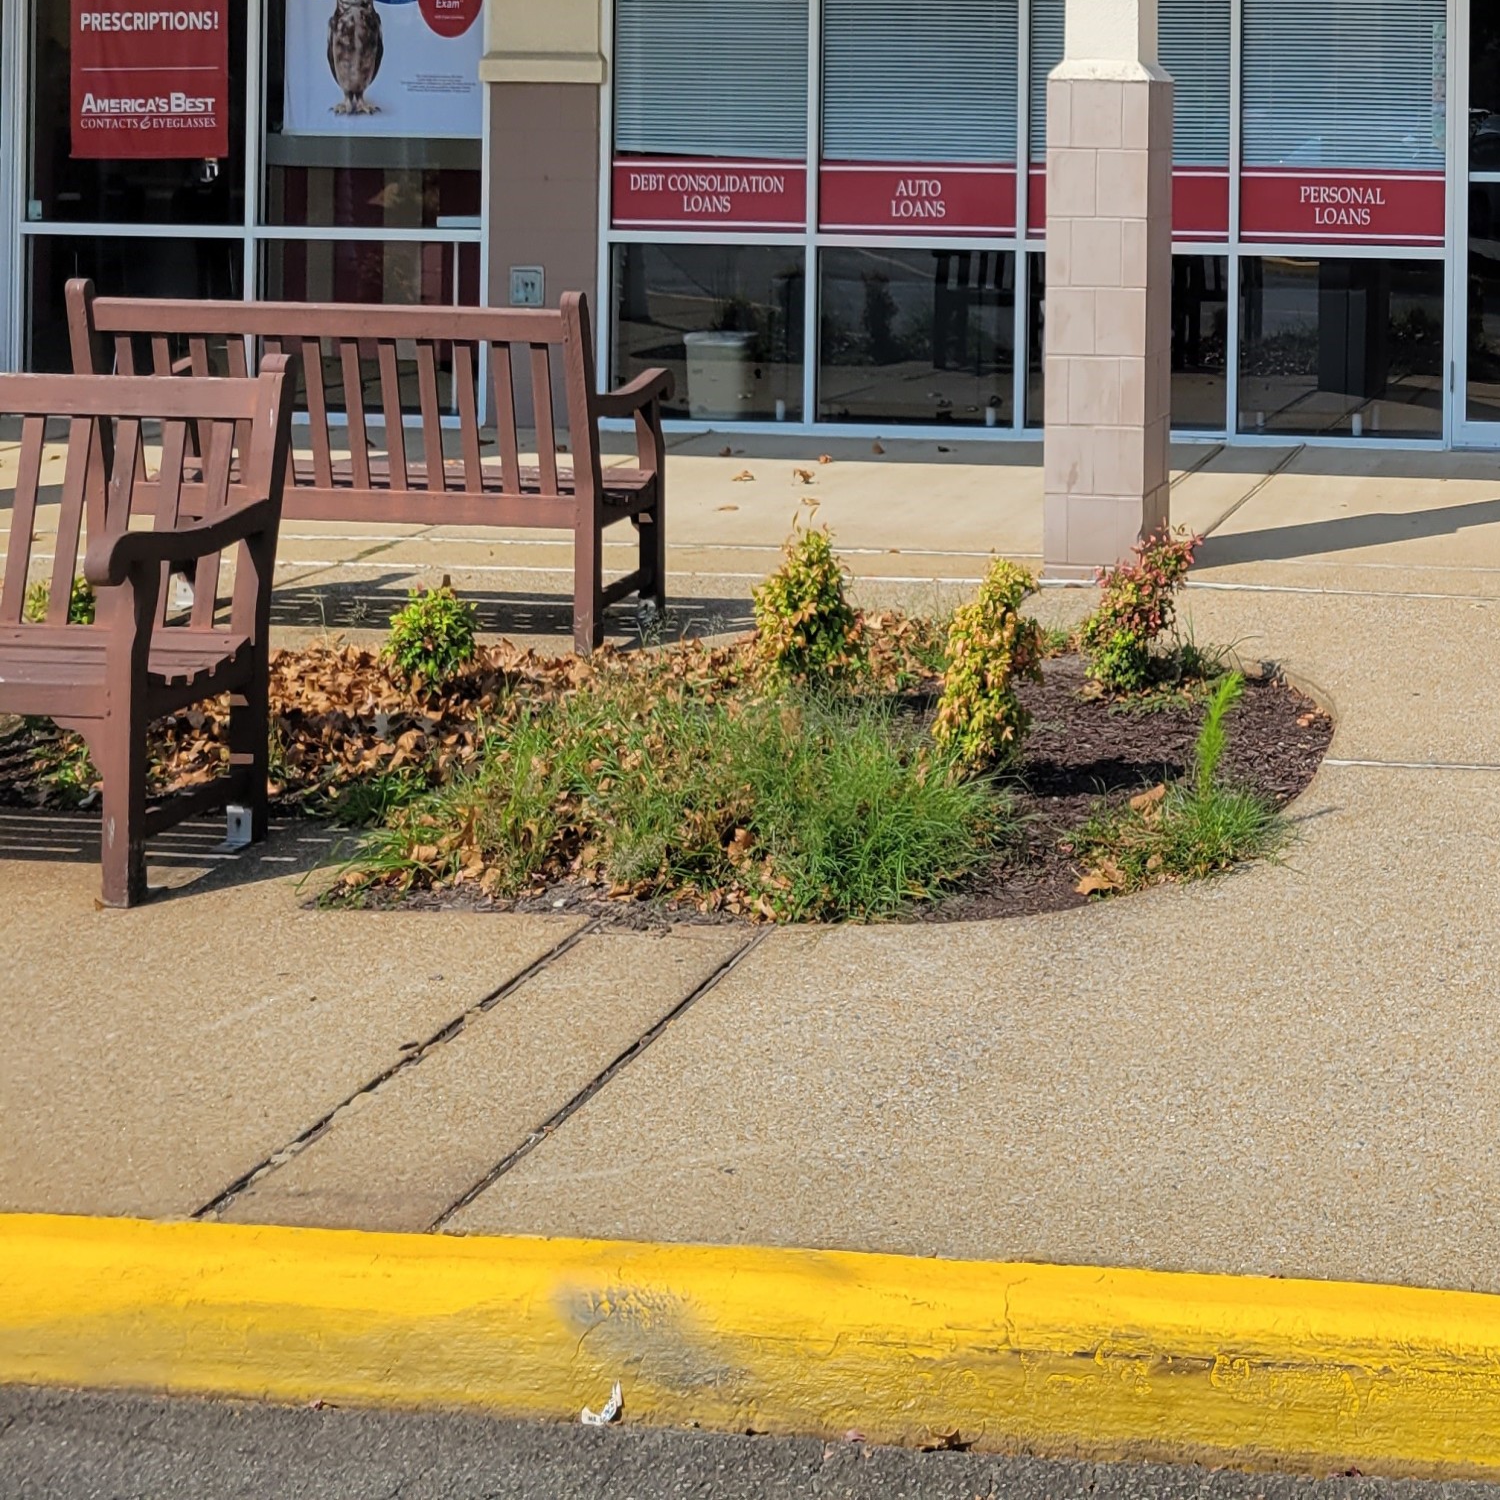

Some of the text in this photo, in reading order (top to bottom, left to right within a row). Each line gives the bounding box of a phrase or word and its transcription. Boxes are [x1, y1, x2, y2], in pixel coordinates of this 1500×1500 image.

[79, 10, 219, 32] PRESCRIPTIONS!
[80, 117, 138, 129] CONTACTS
[152, 117, 217, 128] EYEGLASSES
[630, 173, 785, 193] DEBT CONSOLIDATION
[895, 179, 942, 197] AUTO
[683, 195, 731, 213] LOANS
[1299, 185, 1386, 205] PERSONAL
[891, 199, 946, 218] LOANS
[1314, 207, 1371, 225] LOANS
